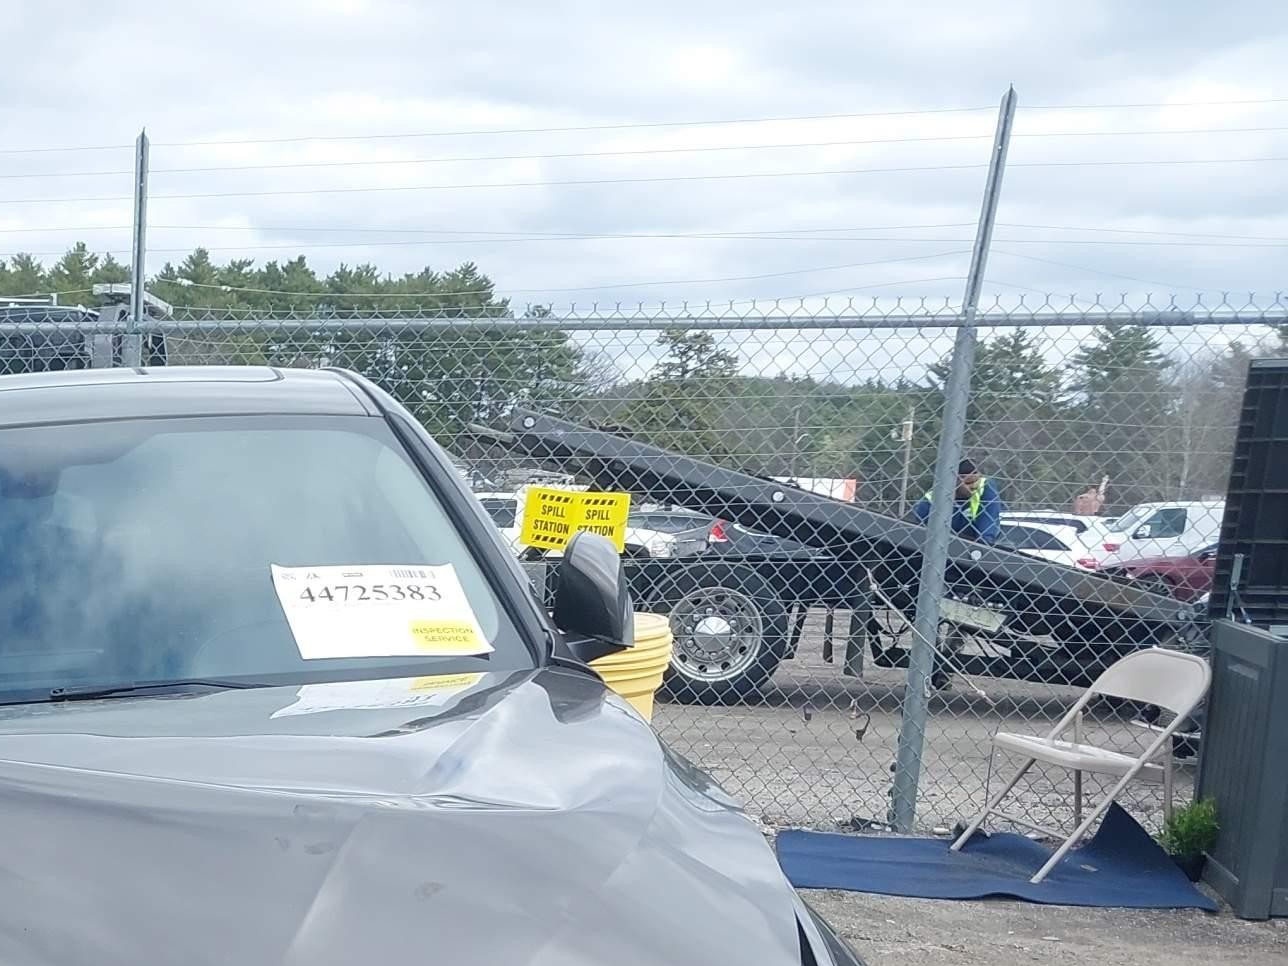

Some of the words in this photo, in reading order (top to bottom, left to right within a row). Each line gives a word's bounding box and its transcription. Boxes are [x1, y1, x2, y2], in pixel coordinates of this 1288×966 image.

[541, 504, 566, 518] SPILL
[585, 509, 610, 520] SPILL
[533, 519, 570, 535] STATION
[299, 584, 442, 602] 44725383
